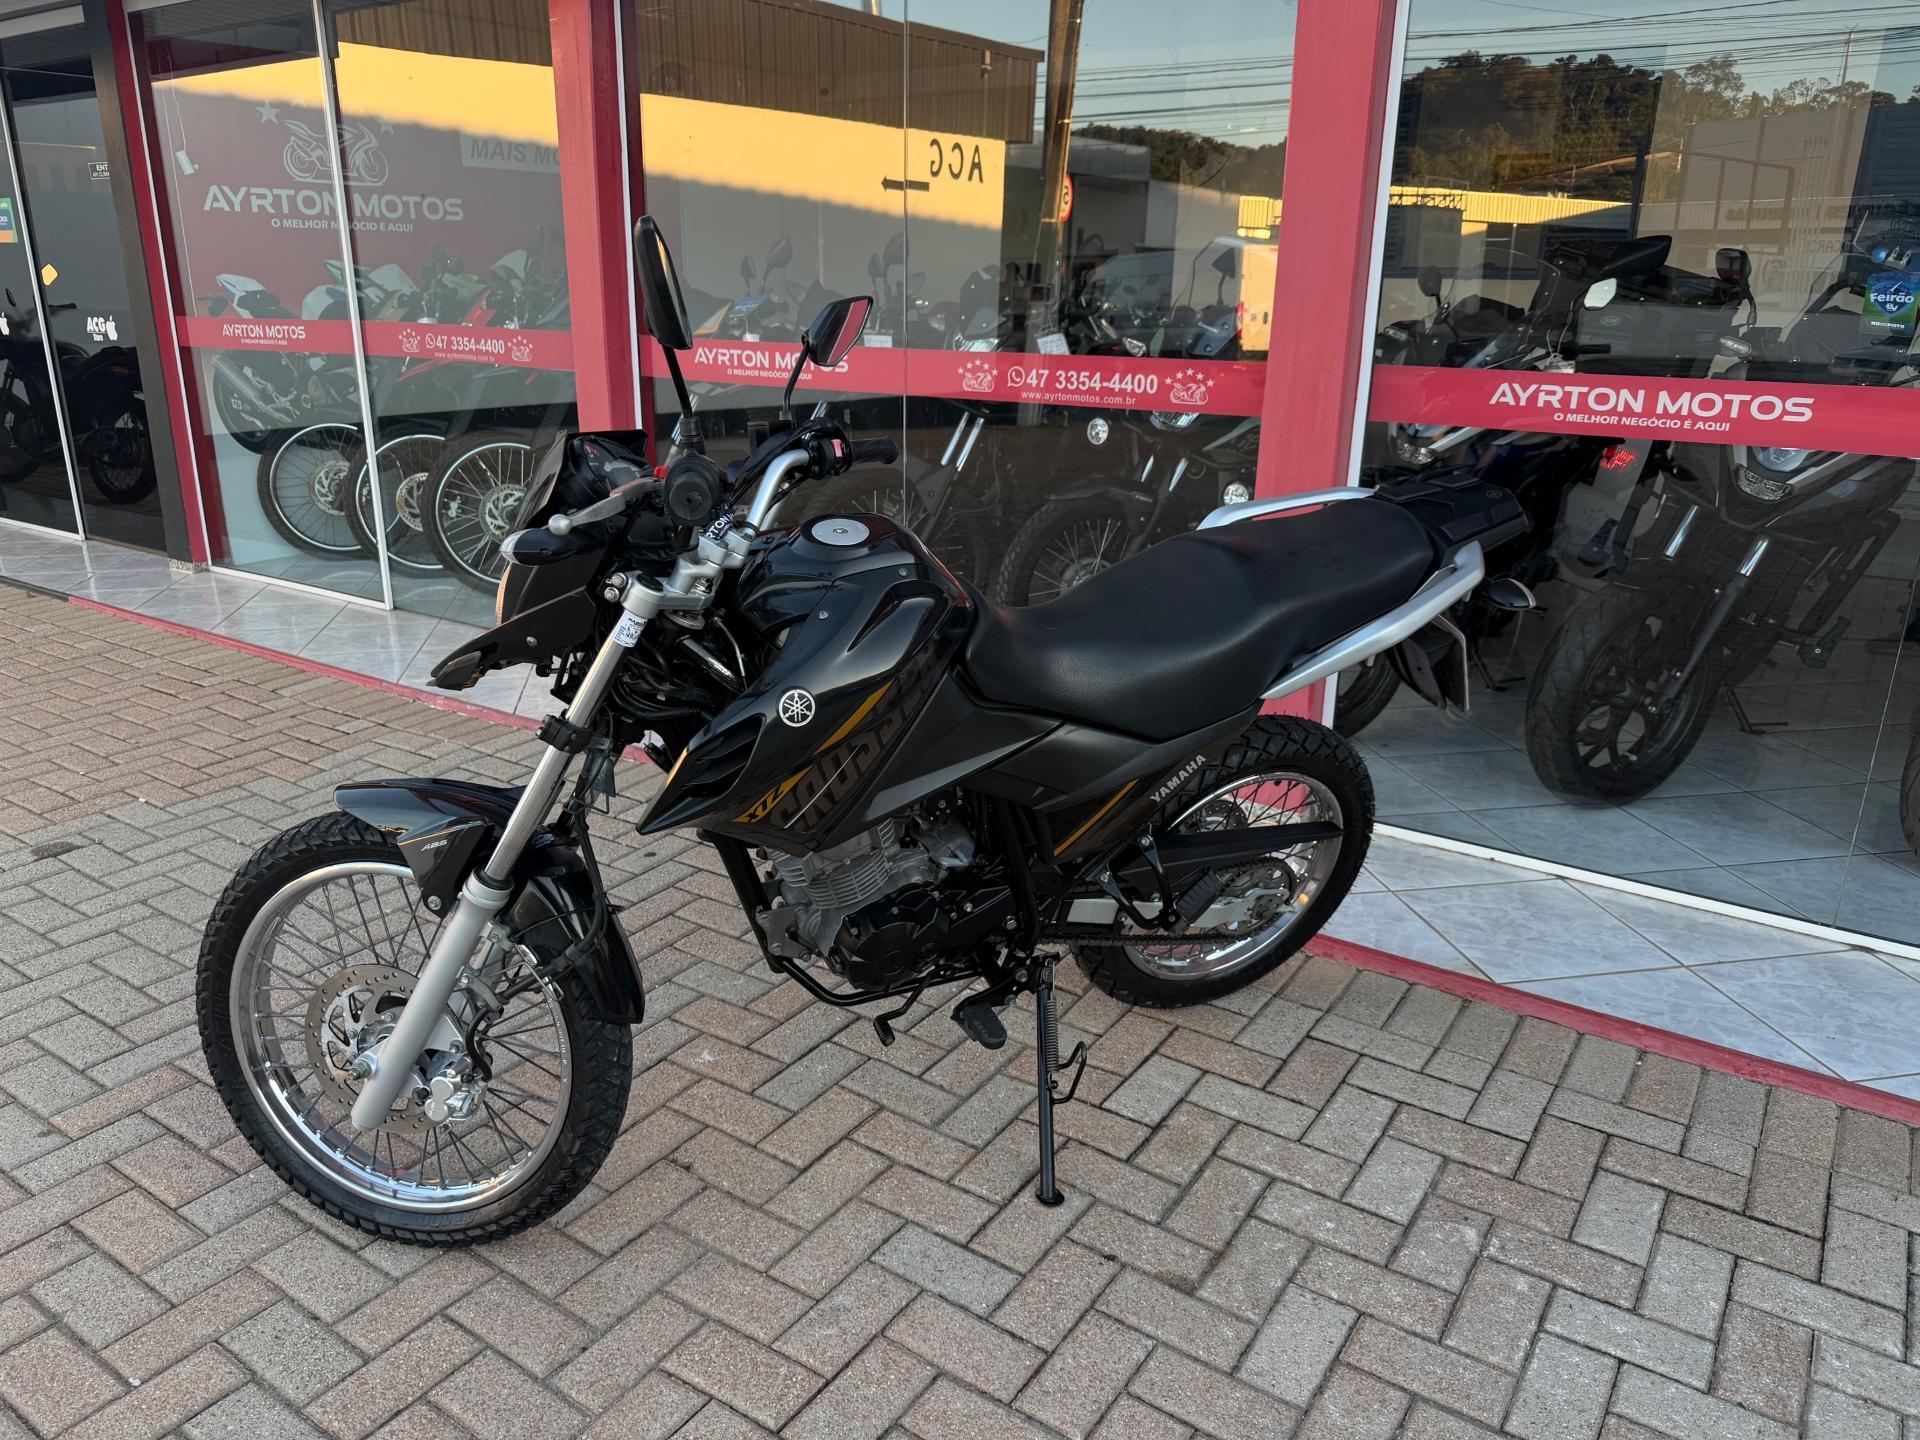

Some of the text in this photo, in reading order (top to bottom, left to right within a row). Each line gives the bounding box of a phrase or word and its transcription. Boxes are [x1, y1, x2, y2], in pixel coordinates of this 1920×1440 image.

[471, 138, 527, 162] MAIS
[203, 184, 464, 221] AYRTON MOTOS
[271, 218, 280, 228] O
[283, 219, 328, 229] MELHOR
[331, 219, 377, 231] NÓCIO
[388, 223, 414, 232] AQUI
[1870, 292, 1915, 303] Feirão
[86, 316, 106, 332] ACG
[222, 323, 306, 339] AYRTON MOTOS
[436, 335, 505, 354] 47 3354-4400
[694, 347, 770, 369] AYRTON
[733, 369, 759, 377] MELHOR
[1026, 368, 1158, 394] 47 3354-4400
[1021, 391, 1136, 405] www.ayrtonmotos.com.br
[1488, 382, 1815, 422] AYRTON MOTOS
[1553, 412, 1730, 432] O MELHOR NEGÓCIO É AQUI
[1149, 754, 1207, 802] YAMAHA
[745, 784, 785, 821] XTZ
[421, 839, 448, 851] ABS
